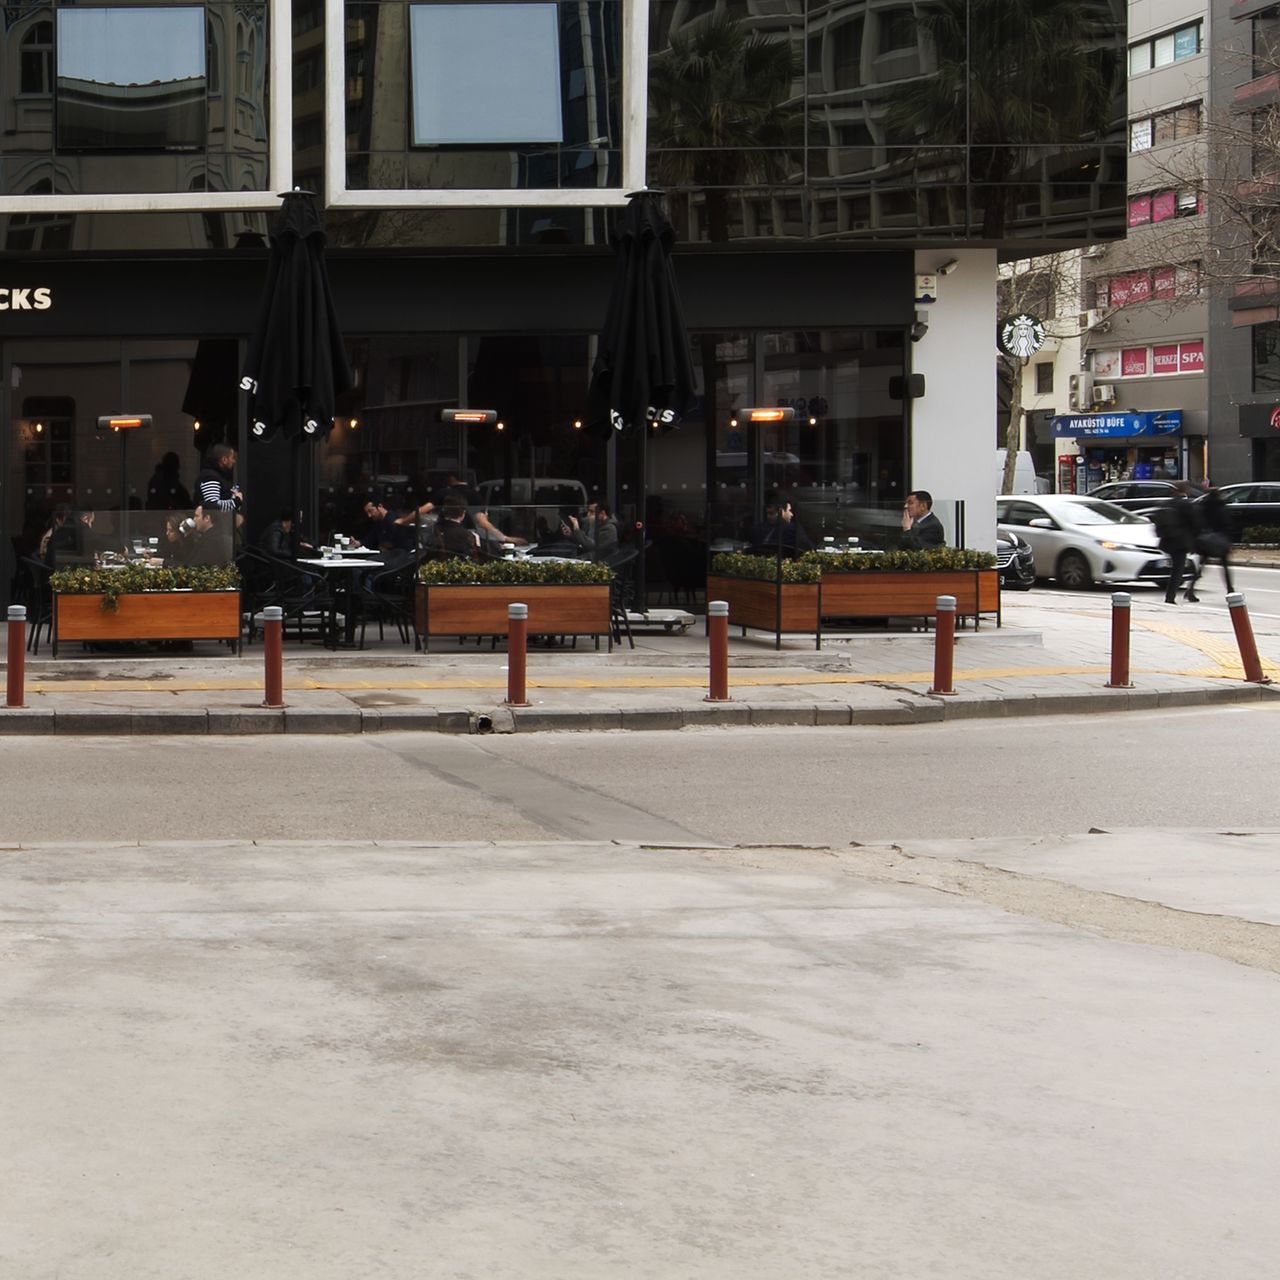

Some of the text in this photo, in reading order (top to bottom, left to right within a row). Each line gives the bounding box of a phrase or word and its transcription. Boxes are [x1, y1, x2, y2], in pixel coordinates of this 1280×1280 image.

[1181, 352, 1205, 364] SPA
[1069, 416, 1125, 429] AYAKÜSTÜ BÜFE
